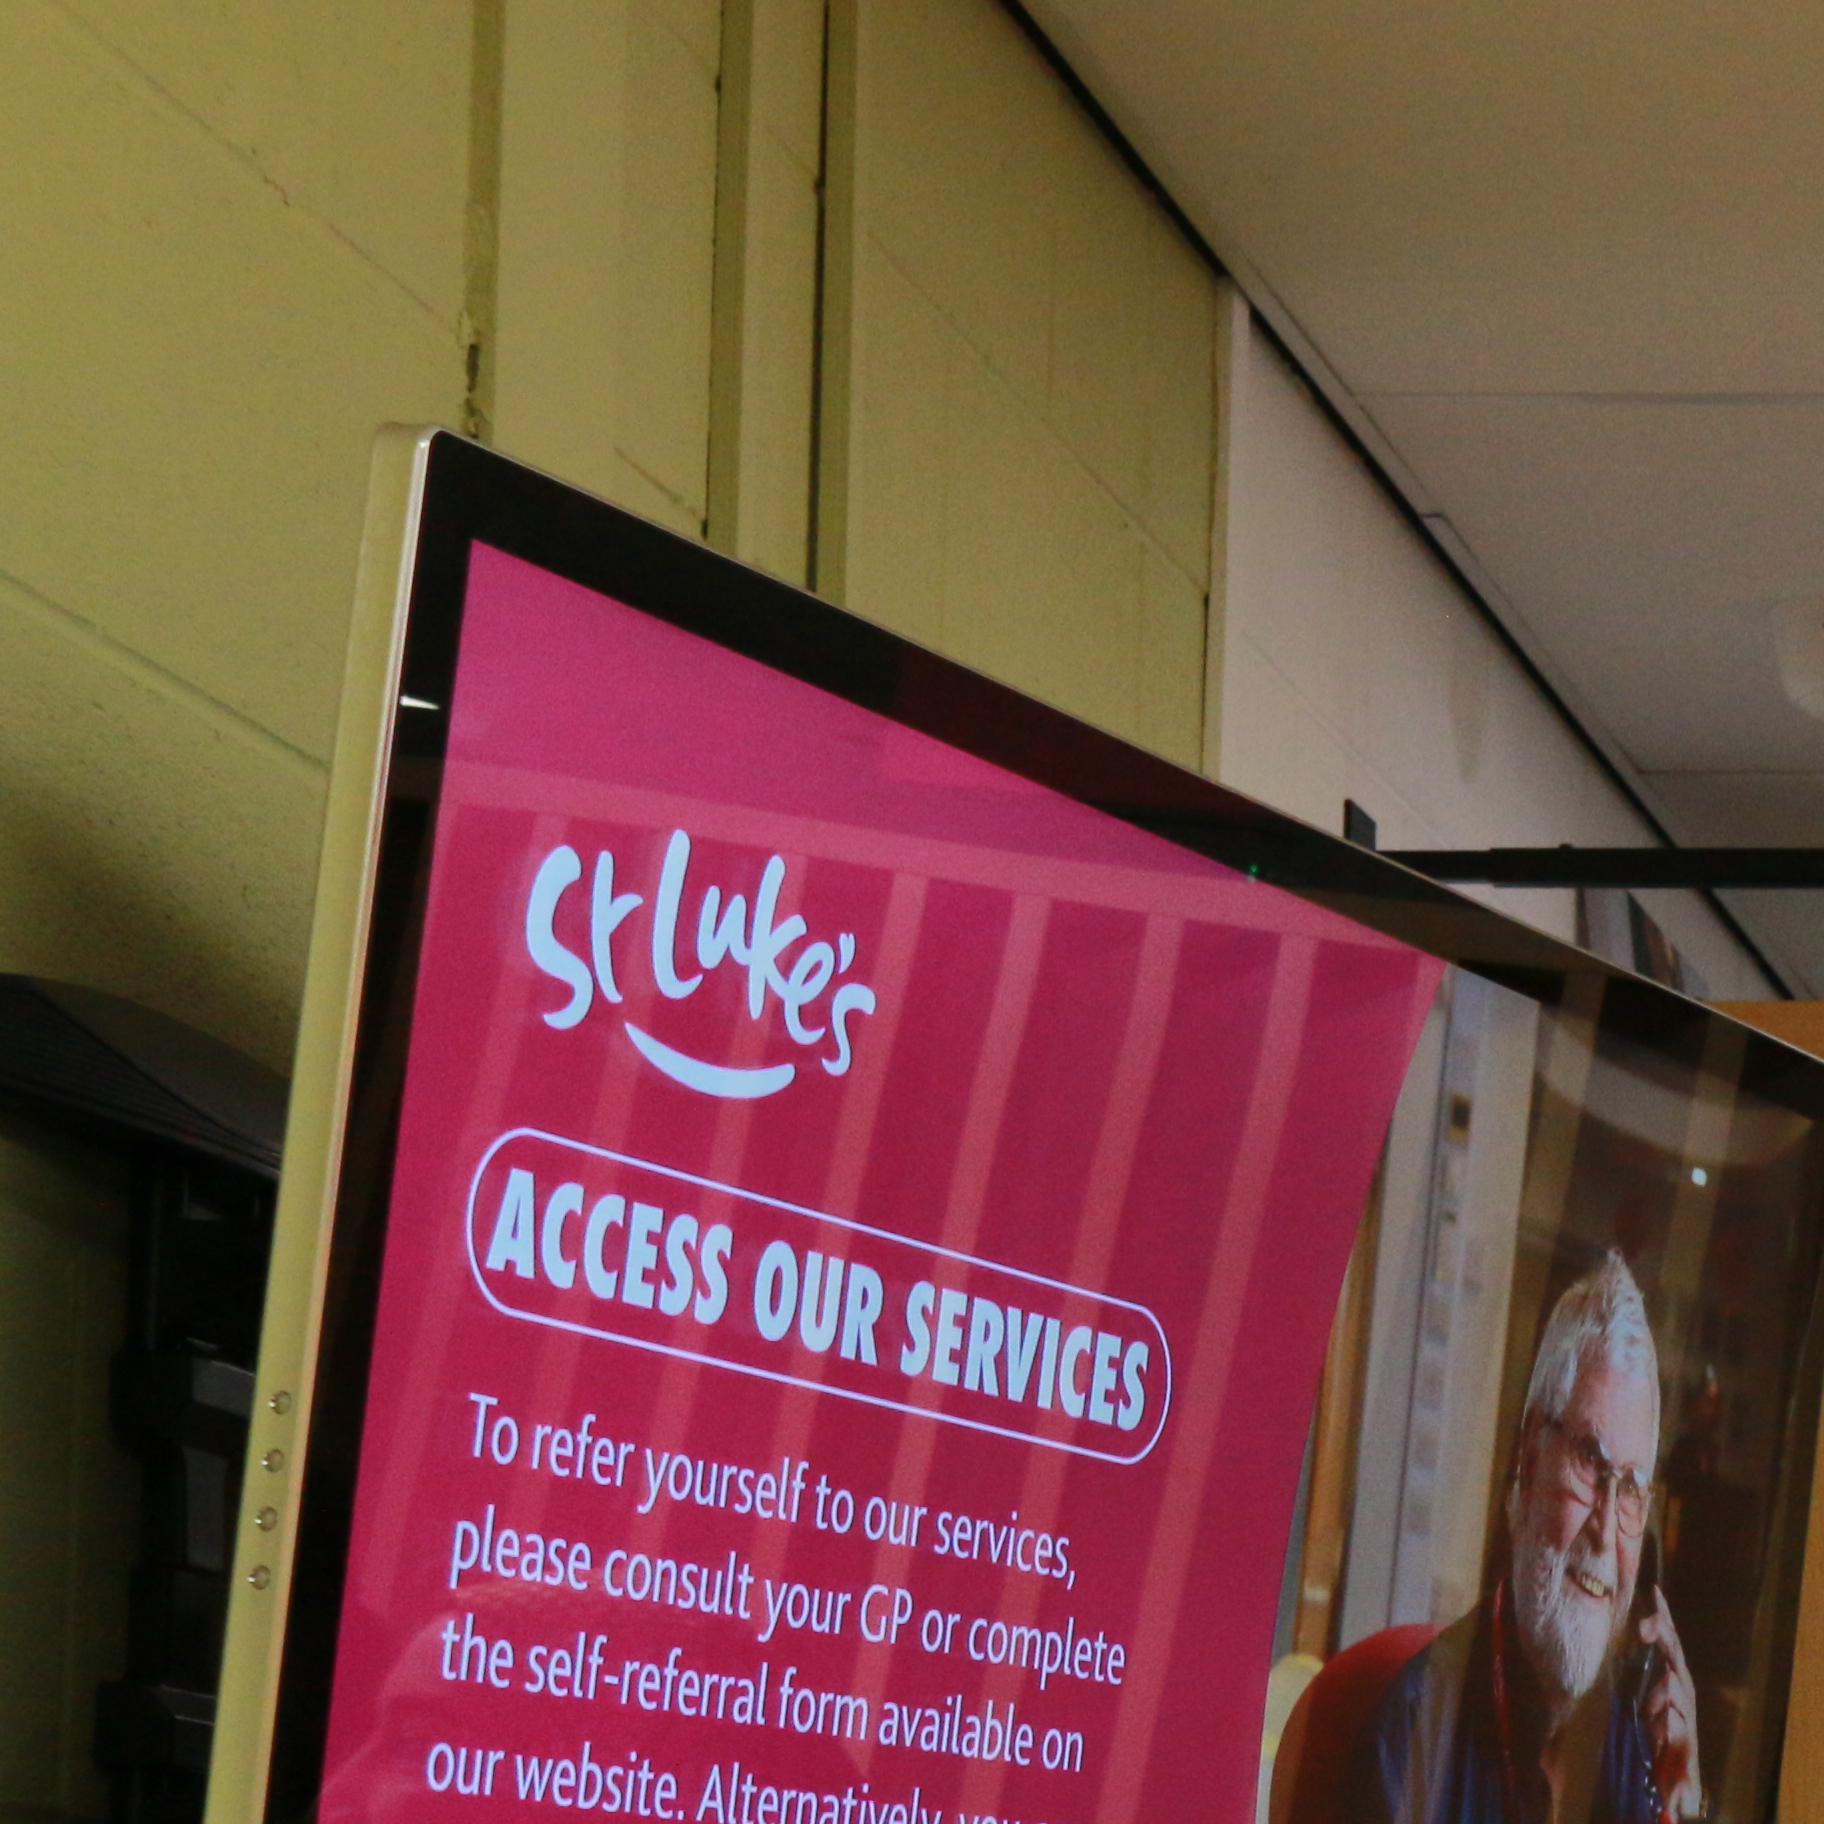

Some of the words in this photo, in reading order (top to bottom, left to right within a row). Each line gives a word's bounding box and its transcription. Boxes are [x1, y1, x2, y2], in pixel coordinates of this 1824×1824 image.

[525, 845, 645, 1029] St
[652, 829, 876, 1076] Luke's
[485, 1168, 733, 1325] ACCESS
[754, 1241, 884, 1365] OUR
[900, 1281, 1150, 1430] SERVICES
[469, 1392, 519, 1465] To
[531, 1413, 636, 1487] refer
[636, 1448, 810, 1523] yourself
[815, 1475, 854, 1534] to
[864, 1496, 928, 1547] our
[933, 1511, 1075, 1590] services,
[440, 1612, 514, 1688] the
[524, 1631, 768, 1725] self-referral
[778, 1666, 869, 1741] form
[878, 1694, 1033, 1766] available
[1042, 1728, 1083, 1773] on
[449, 1503, 591, 1591] please
[603, 1549, 755, 1620] consult
[757, 1579, 852, 1643] your
[860, 1584, 913, 1644] GP
[921, 1609, 961, 1654] or
[968, 1616, 1125, 1691] complete
[426, 1742, 505, 1796] our
[515, 1741, 684, 1821] website.
